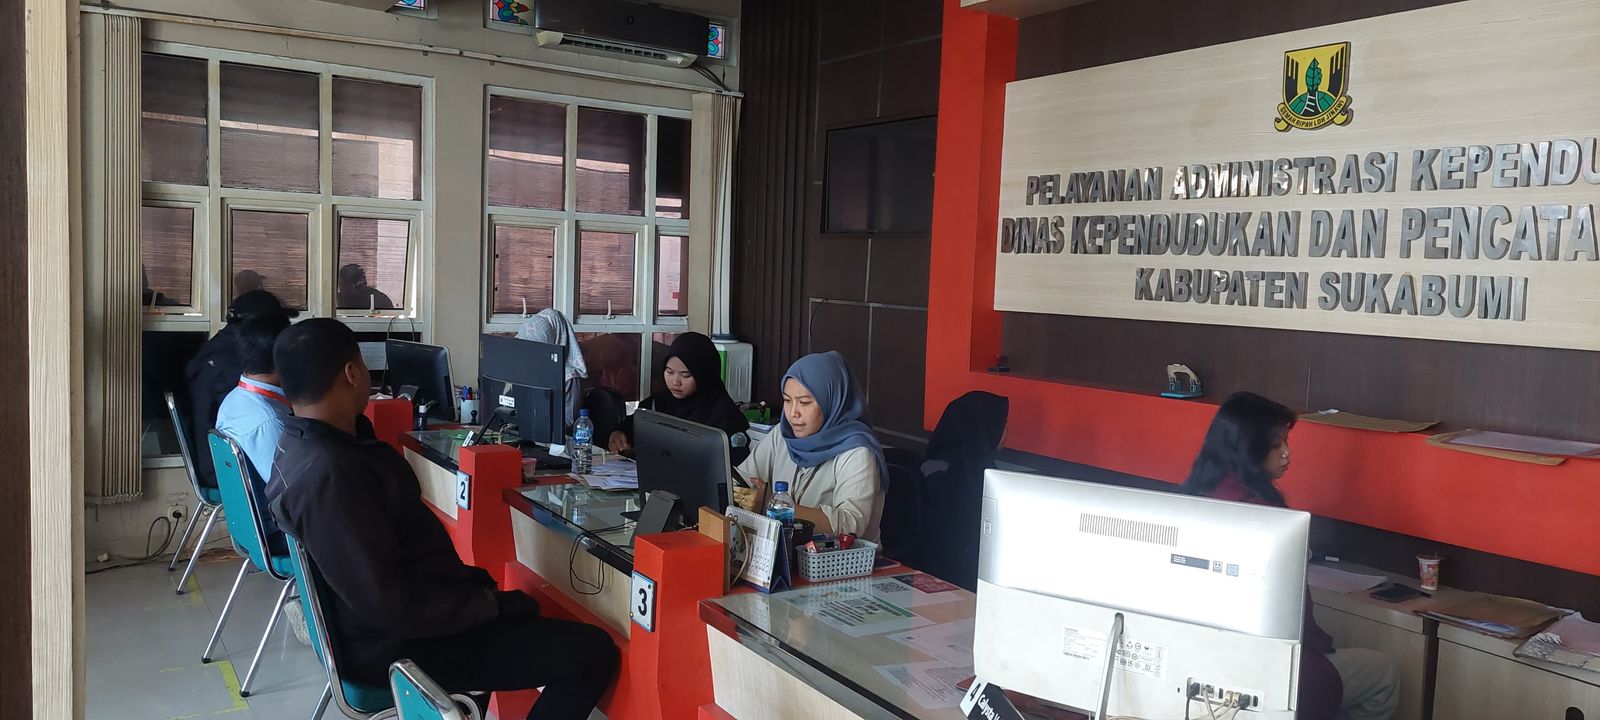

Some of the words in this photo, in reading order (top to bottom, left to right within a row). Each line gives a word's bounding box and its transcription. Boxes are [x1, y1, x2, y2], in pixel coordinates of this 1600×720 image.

[1280, 106, 1297, 124] GEMAH
[1295, 119, 1313, 128] RIPAH
[1313, 117, 1326, 126] LOH
[1326, 99, 1345, 120] JINAWI
[1026, 167, 1163, 205] PELAYANAN
[1170, 151, 1398, 199] ADMINISTRASI
[1410, 137, 1600, 191] KEPENDU
[1001, 215, 1064, 254] DINAS
[1070, 210, 1301, 257] KEPENDUDUKAN
[1308, 208, 1388, 258] DAN
[1400, 204, 1600, 261] PENCATA
[1134, 267, 1309, 309] KABUPATEN
[1317, 271, 1529, 321] SUKABUMI
[460, 481, 466, 500] 2
[637, 588, 648, 616] 3
[970, 682, 981, 701] 4
